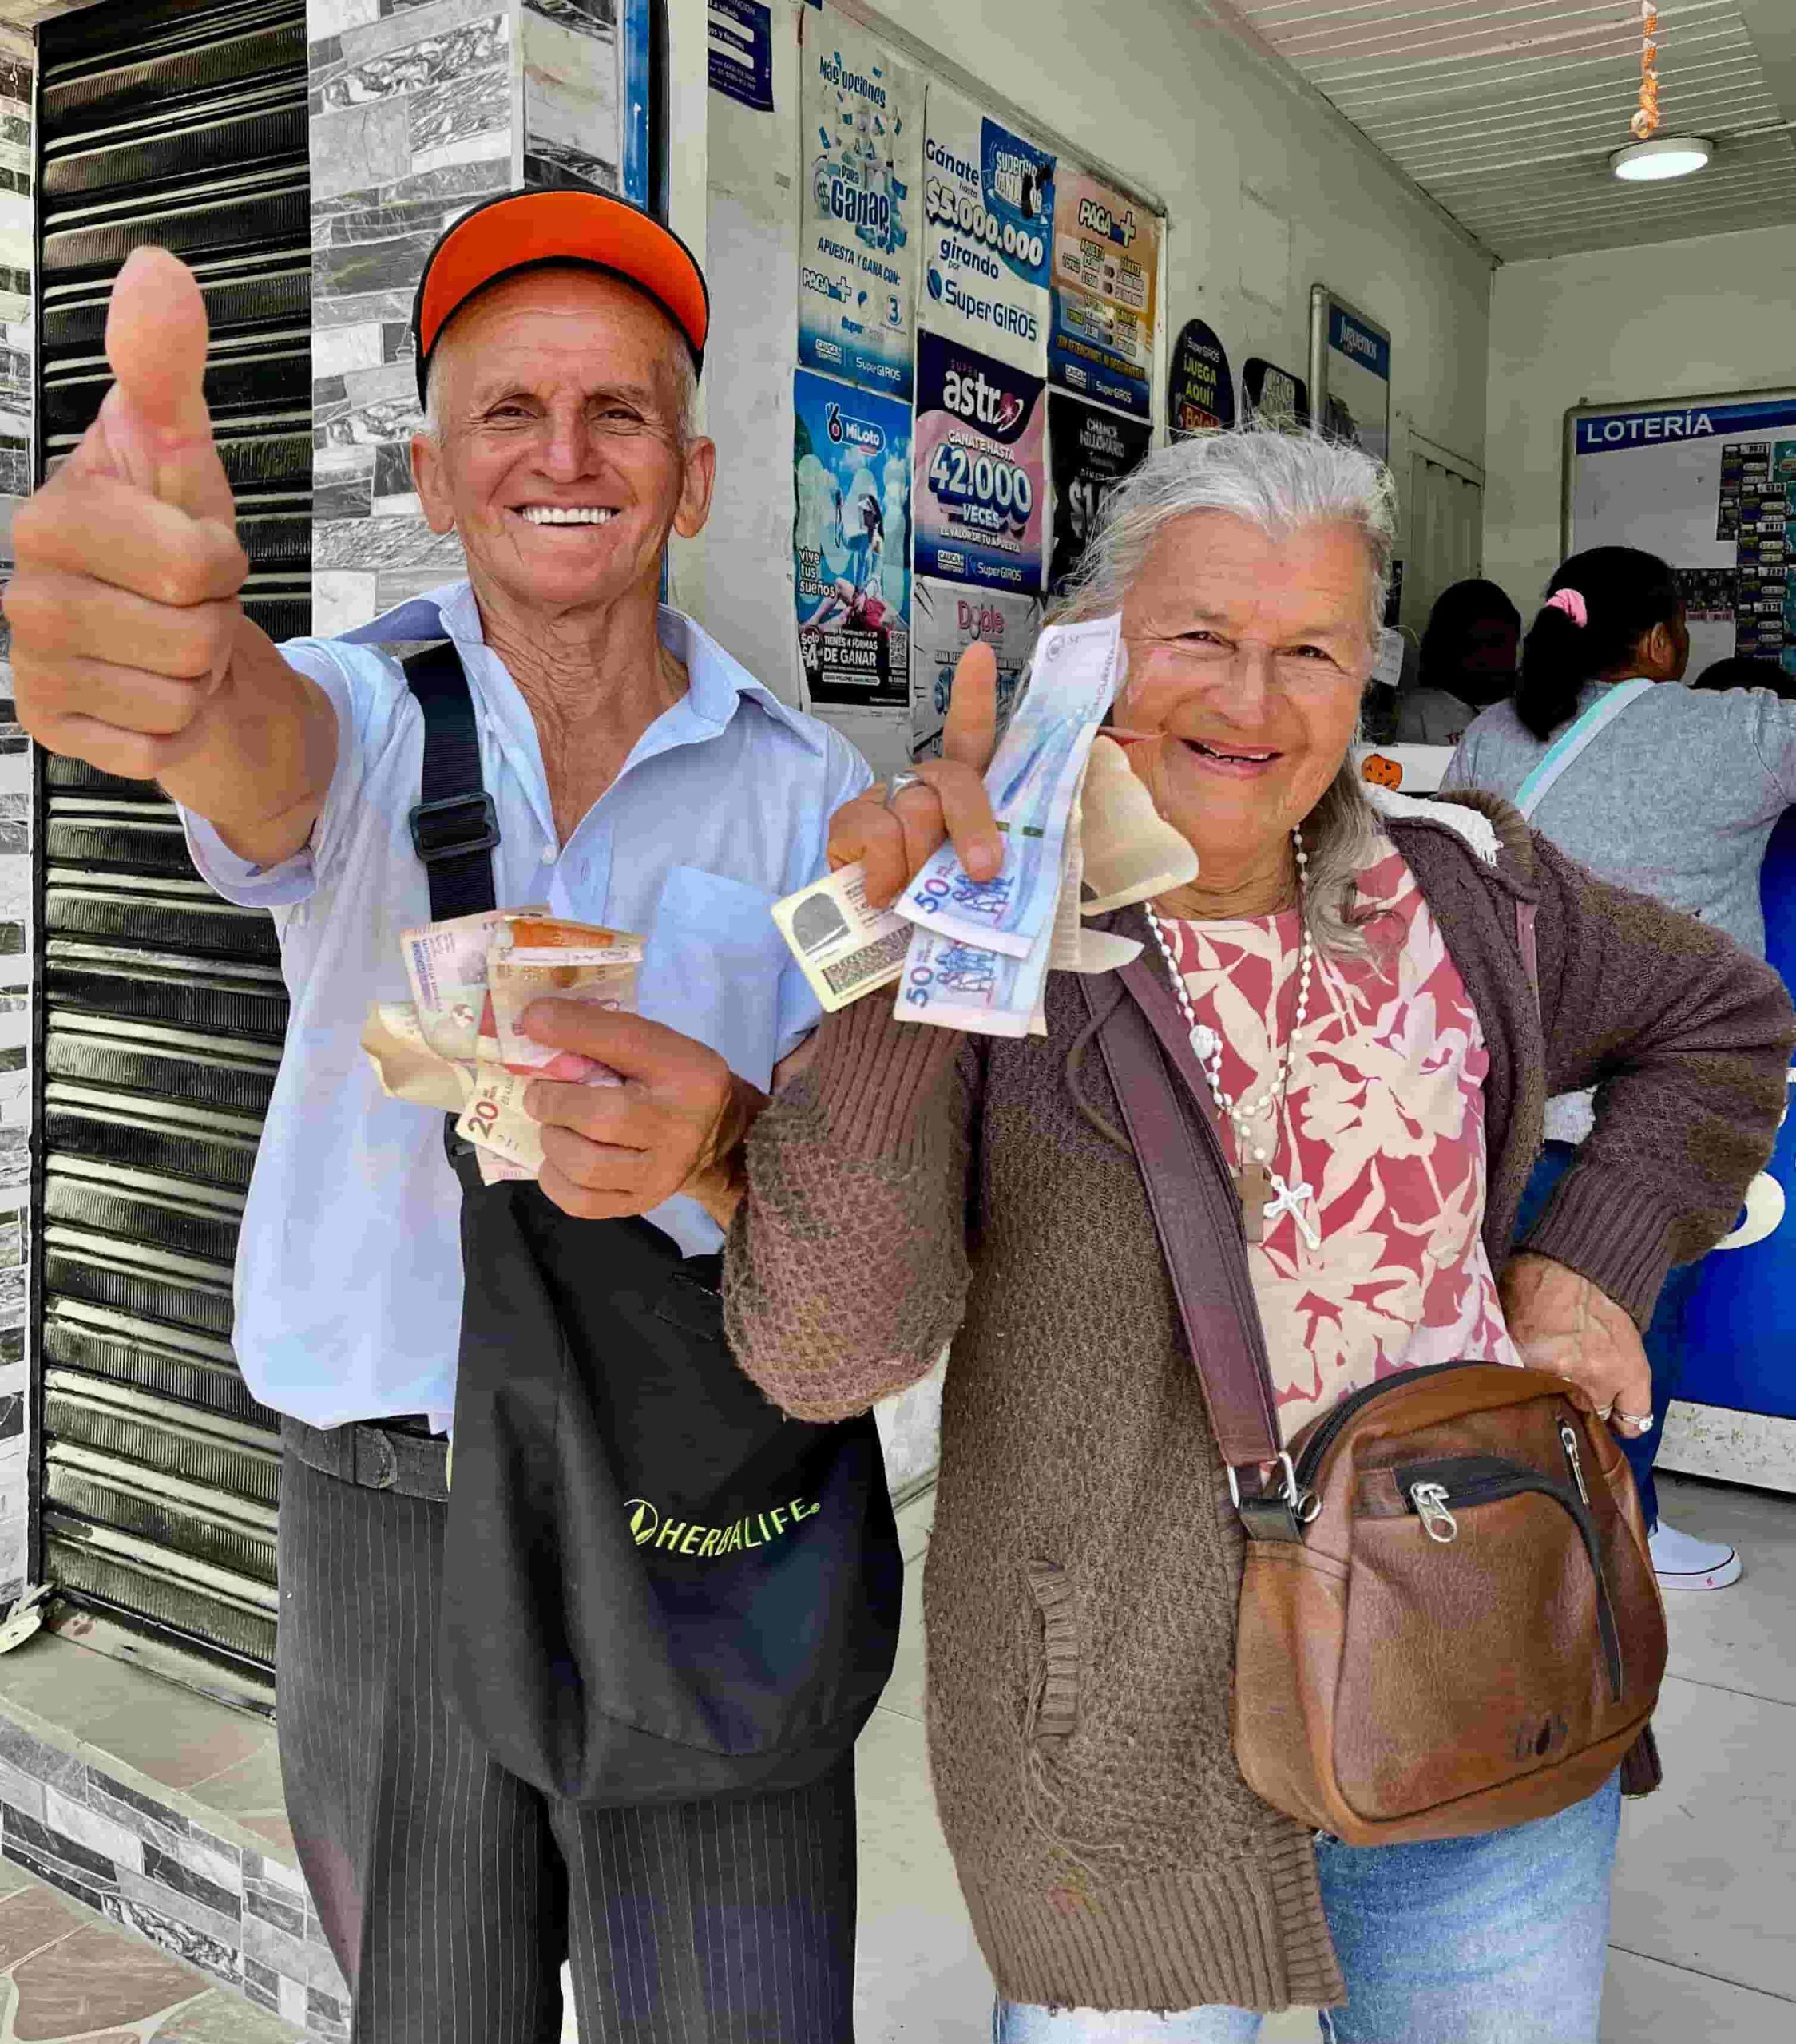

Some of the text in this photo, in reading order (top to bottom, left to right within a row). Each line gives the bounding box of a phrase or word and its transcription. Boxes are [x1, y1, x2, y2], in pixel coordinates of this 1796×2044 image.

[819, 56, 886, 109] Más opciones
[926, 138, 980, 186] Gánate
[926, 176, 1045, 268] $5.000.000
[817, 237, 854, 266] APUESTA
[856, 253, 862, 267] Y
[862, 256, 882, 278] GANA
[940, 237, 999, 279] girando
[846, 423, 880, 446] MiLoto
[1586, 410, 1715, 443] LOTERÍA
[988, 440, 1016, 463] HASTA
[930, 443, 1033, 515] 42.000
[950, 526, 972, 539] VALOR
[962, 503, 1000, 529] VECES
[799, 547, 820, 564] vive
[800, 564, 816, 579] tus
[799, 580, 836, 597] sueños
[801, 632, 819, 645] Solo
[823, 635, 878, 651] TIENES 4 FORMAS
[823, 647, 877, 667] DE GANAR
[914, 879, 950, 914] 50
[906, 967, 934, 1008] 50
[468, 1101, 499, 1139] 20
[655, 1497, 805, 1558] HERBALIFE
